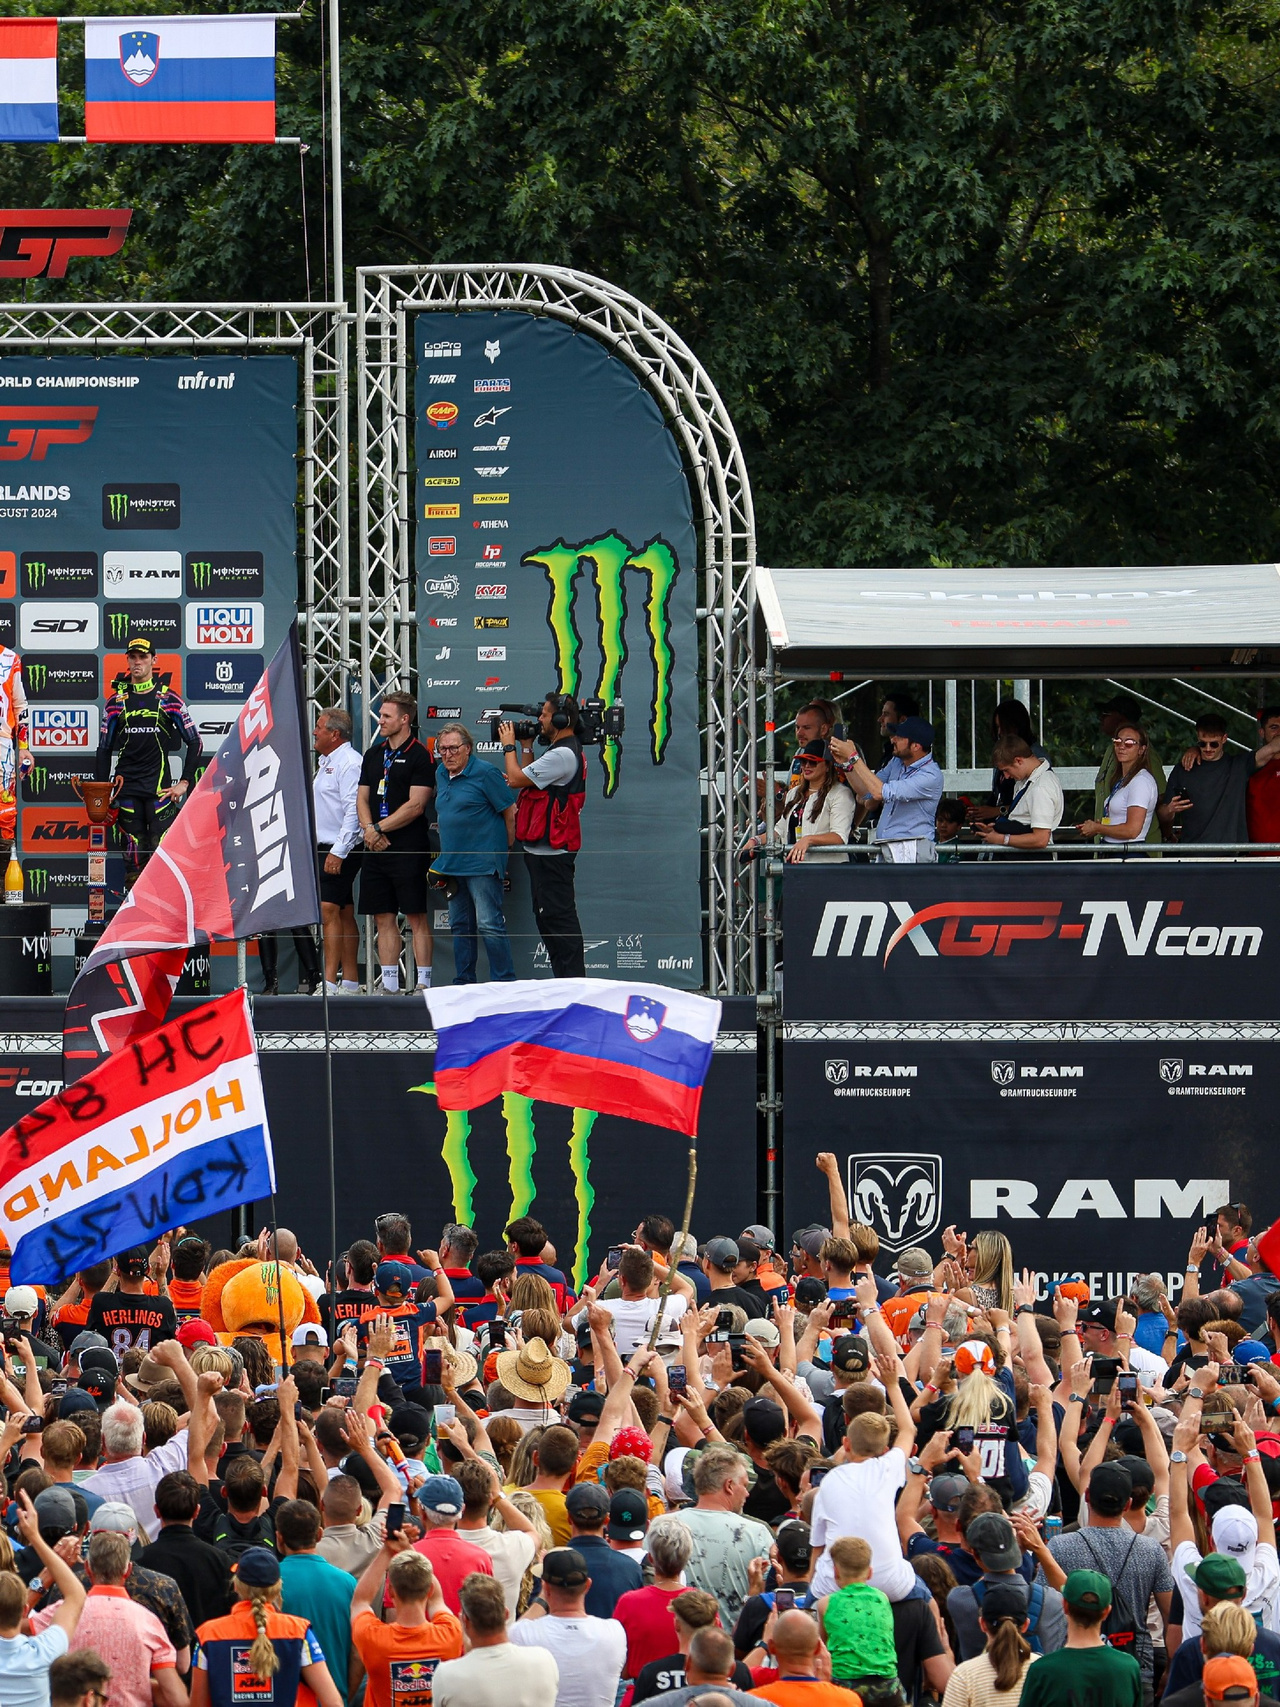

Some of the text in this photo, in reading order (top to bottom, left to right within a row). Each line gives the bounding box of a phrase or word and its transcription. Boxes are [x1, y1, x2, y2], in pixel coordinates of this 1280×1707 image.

[425, 341, 462, 350] GoPro
[36, 376, 140, 388] CHAMPIONSHIP
[475, 378, 510, 387] PARTS
[429, 449, 457, 459] AIROH
[31, 507, 58, 519] 2024
[480, 520, 509, 529] ATHENA
[431, 541, 454, 551] GET
[47, 565, 94, 577] MONSTER
[129, 569, 181, 579] RAM
[212, 565, 260, 577] MONSTER
[429, 582, 452, 591] AFAM
[475, 585, 507, 596] KYB
[130, 617, 177, 628] MONSTER
[199, 608, 251, 625] LIQUI
[199, 627, 252, 643] MOLY
[48, 668, 94, 679] MONSTER
[204, 681, 246, 692] Husqvarna
[433, 679, 461, 687] SCOTT
[34, 710, 86, 728] LIQUI
[124, 726, 161, 734] HONDA
[32, 728, 88, 746] MOLY
[855, 1065, 919, 1077] RAM
[1021, 1066, 1085, 1078] RAM
[1189, 1064, 1253, 1076] RAM
[833, 1087, 911, 1098] @RAMTRUCKSEUROPE
[999, 1087, 1078, 1099] @RAMTRUCKSEUROPE
[1167, 1085, 1247, 1097] @RAMTRUCKSEUROPE
[970, 1179, 1230, 1219] RAM
[102, 1309, 164, 1328] HERLINGS
